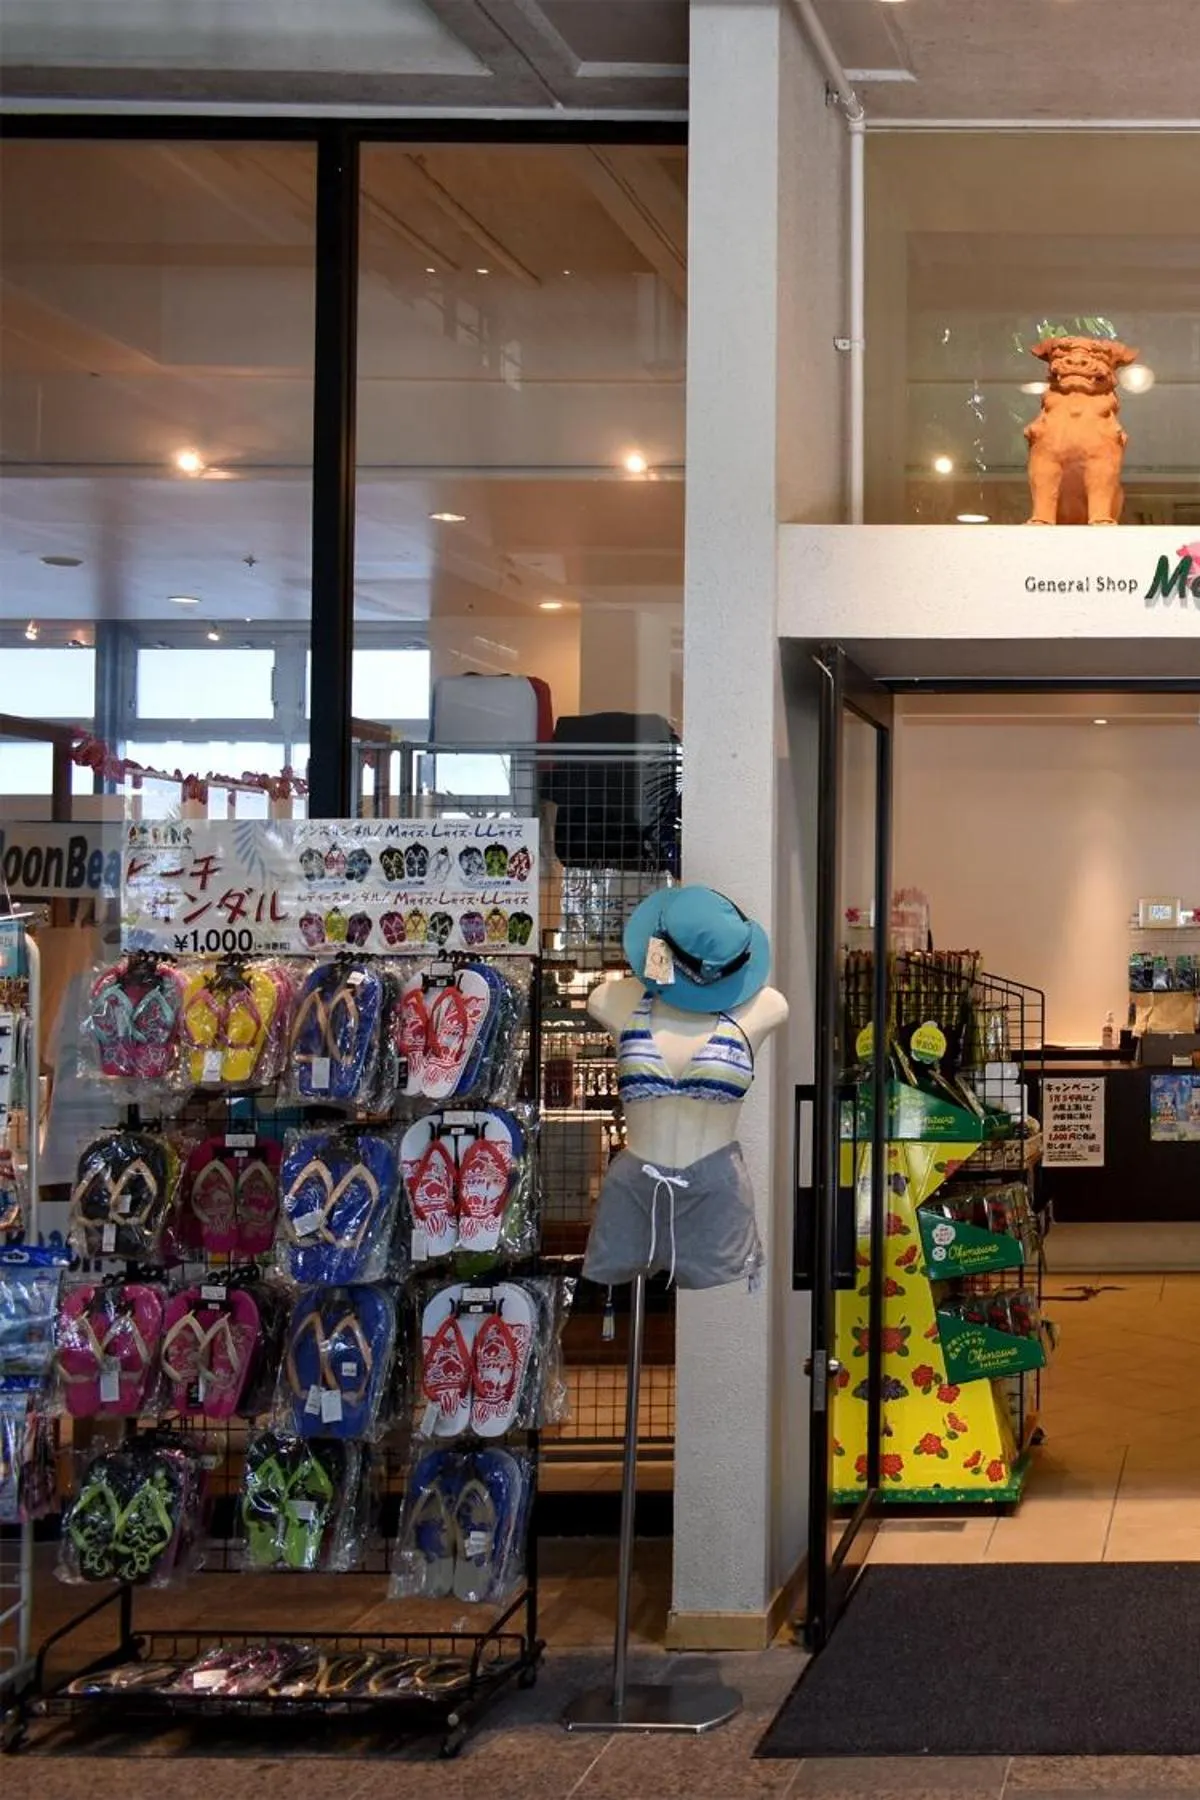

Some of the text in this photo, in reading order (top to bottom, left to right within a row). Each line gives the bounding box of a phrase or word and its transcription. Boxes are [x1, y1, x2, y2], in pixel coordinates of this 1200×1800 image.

[1025, 576, 1089, 592] General
[1096, 576, 1138, 593] Shop
[174, 929, 254, 953] ¥1,000
